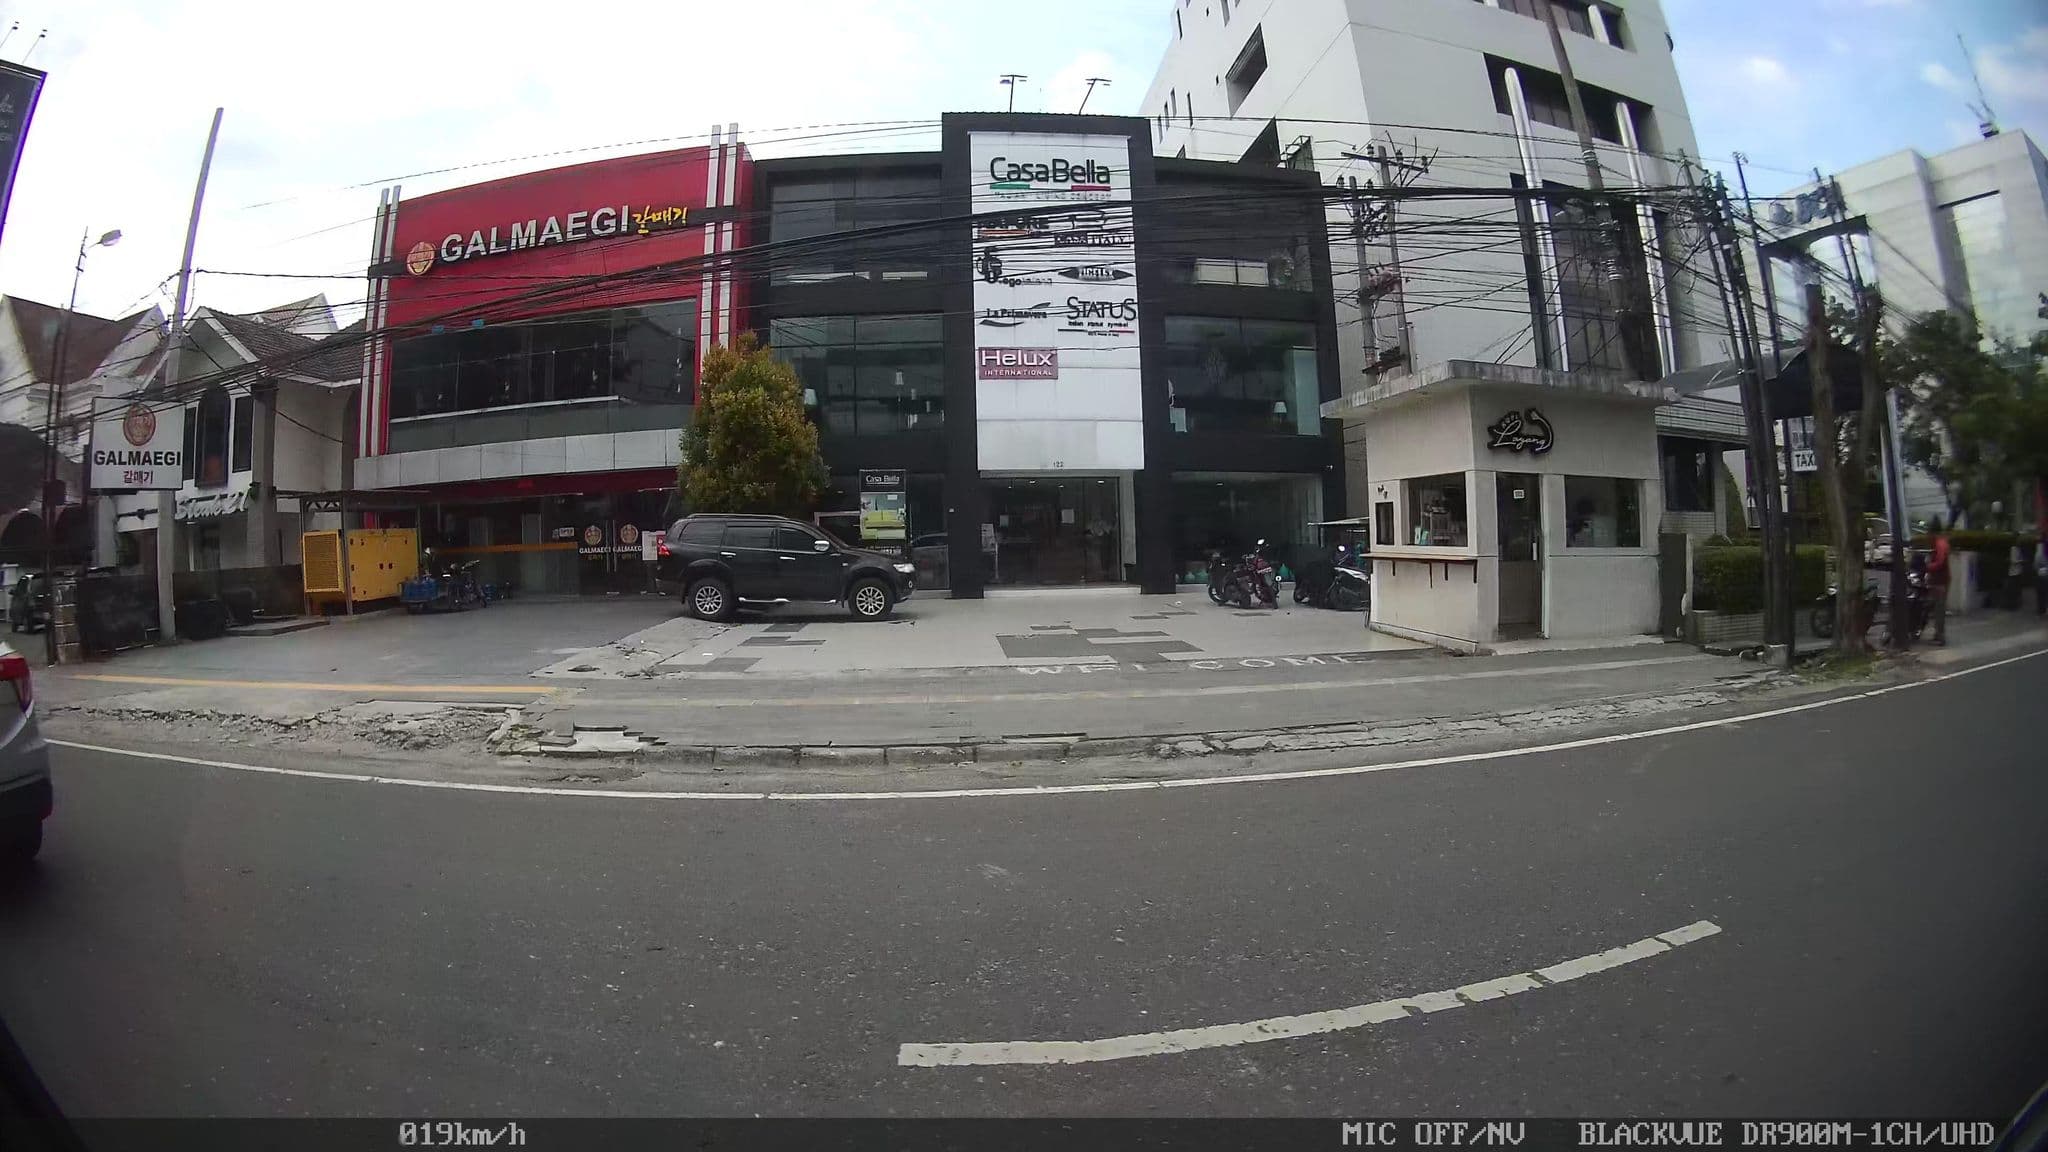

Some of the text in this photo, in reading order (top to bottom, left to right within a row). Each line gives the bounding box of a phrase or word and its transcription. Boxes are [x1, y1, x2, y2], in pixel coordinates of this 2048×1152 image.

[633, 206, 688, 234] 갈매기
[441, 205, 630, 263] GALMAEGI
[1066, 296, 1137, 321] STATUS
[981, 350, 1053, 366] Helux
[93, 450, 182, 467] GALMAEGI
[1795, 453, 1815, 468] TAX
[123, 469, 154, 485] 갈매기
